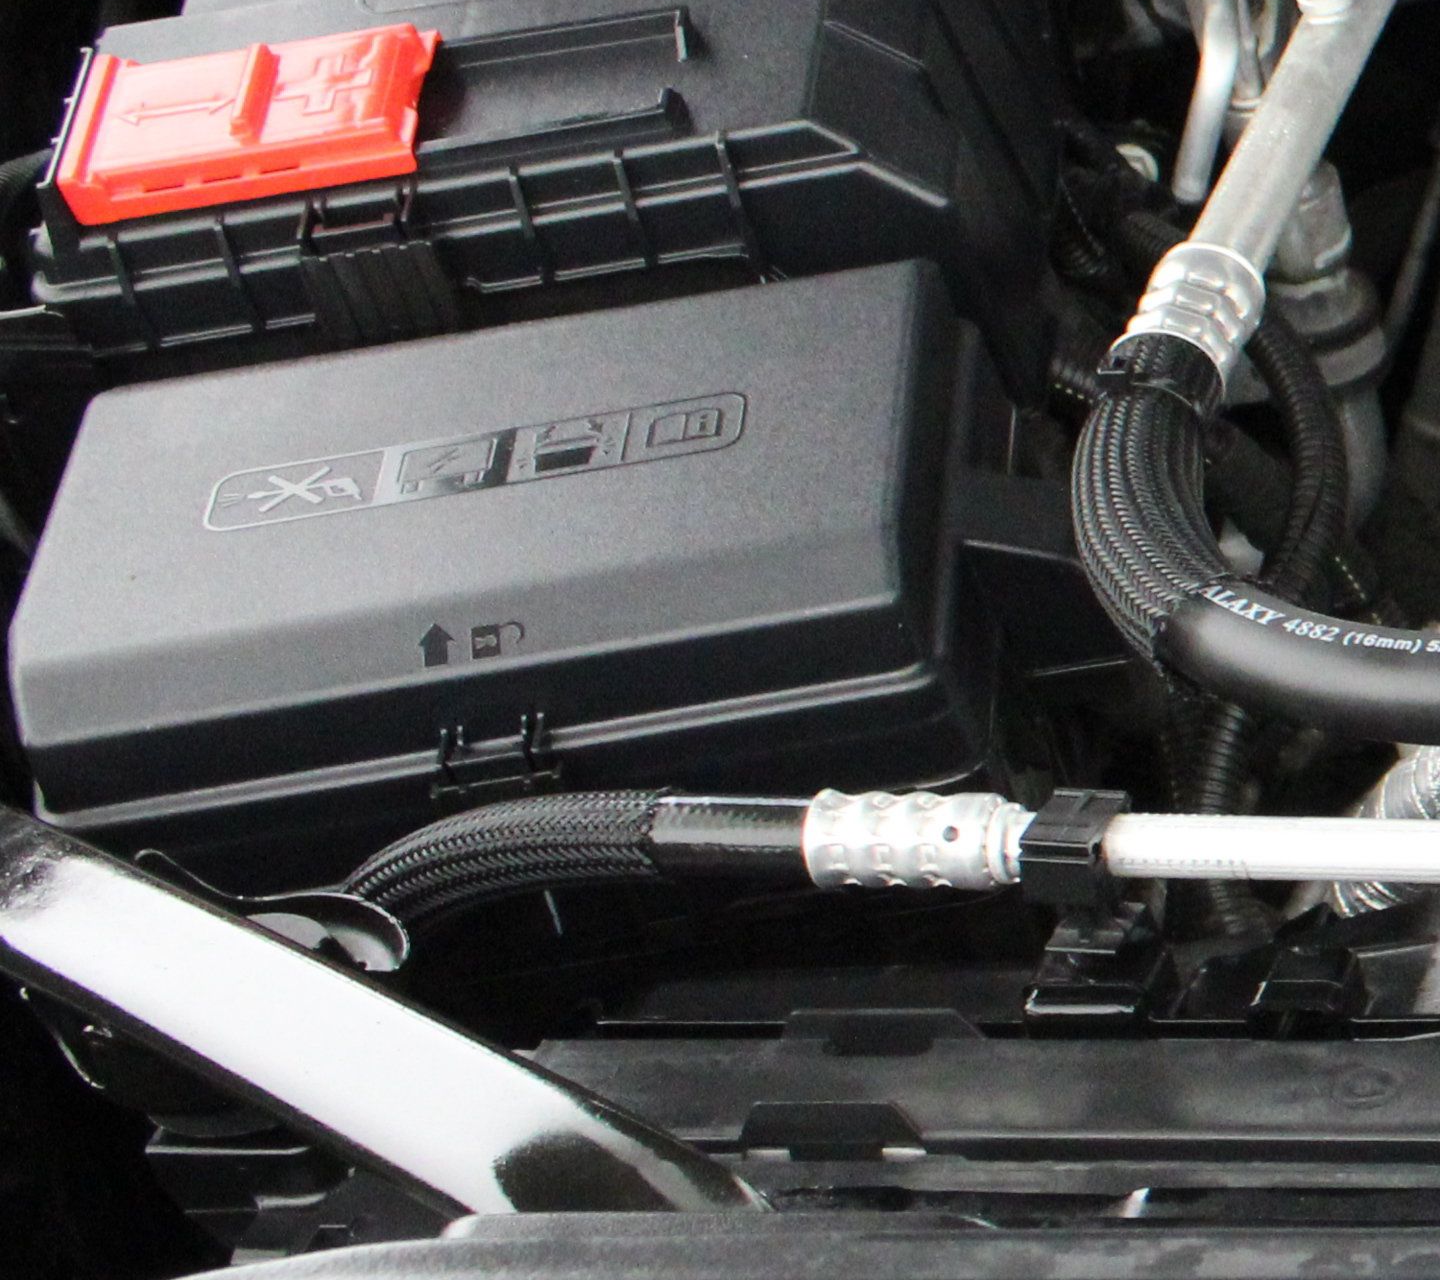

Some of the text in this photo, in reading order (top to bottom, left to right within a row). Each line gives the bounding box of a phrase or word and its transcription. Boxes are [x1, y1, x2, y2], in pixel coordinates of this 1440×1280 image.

[1199, 584, 1286, 625] ALAXY
[1282, 618, 1341, 643] 4882
[1342, 630, 1423, 655] (16mm)
